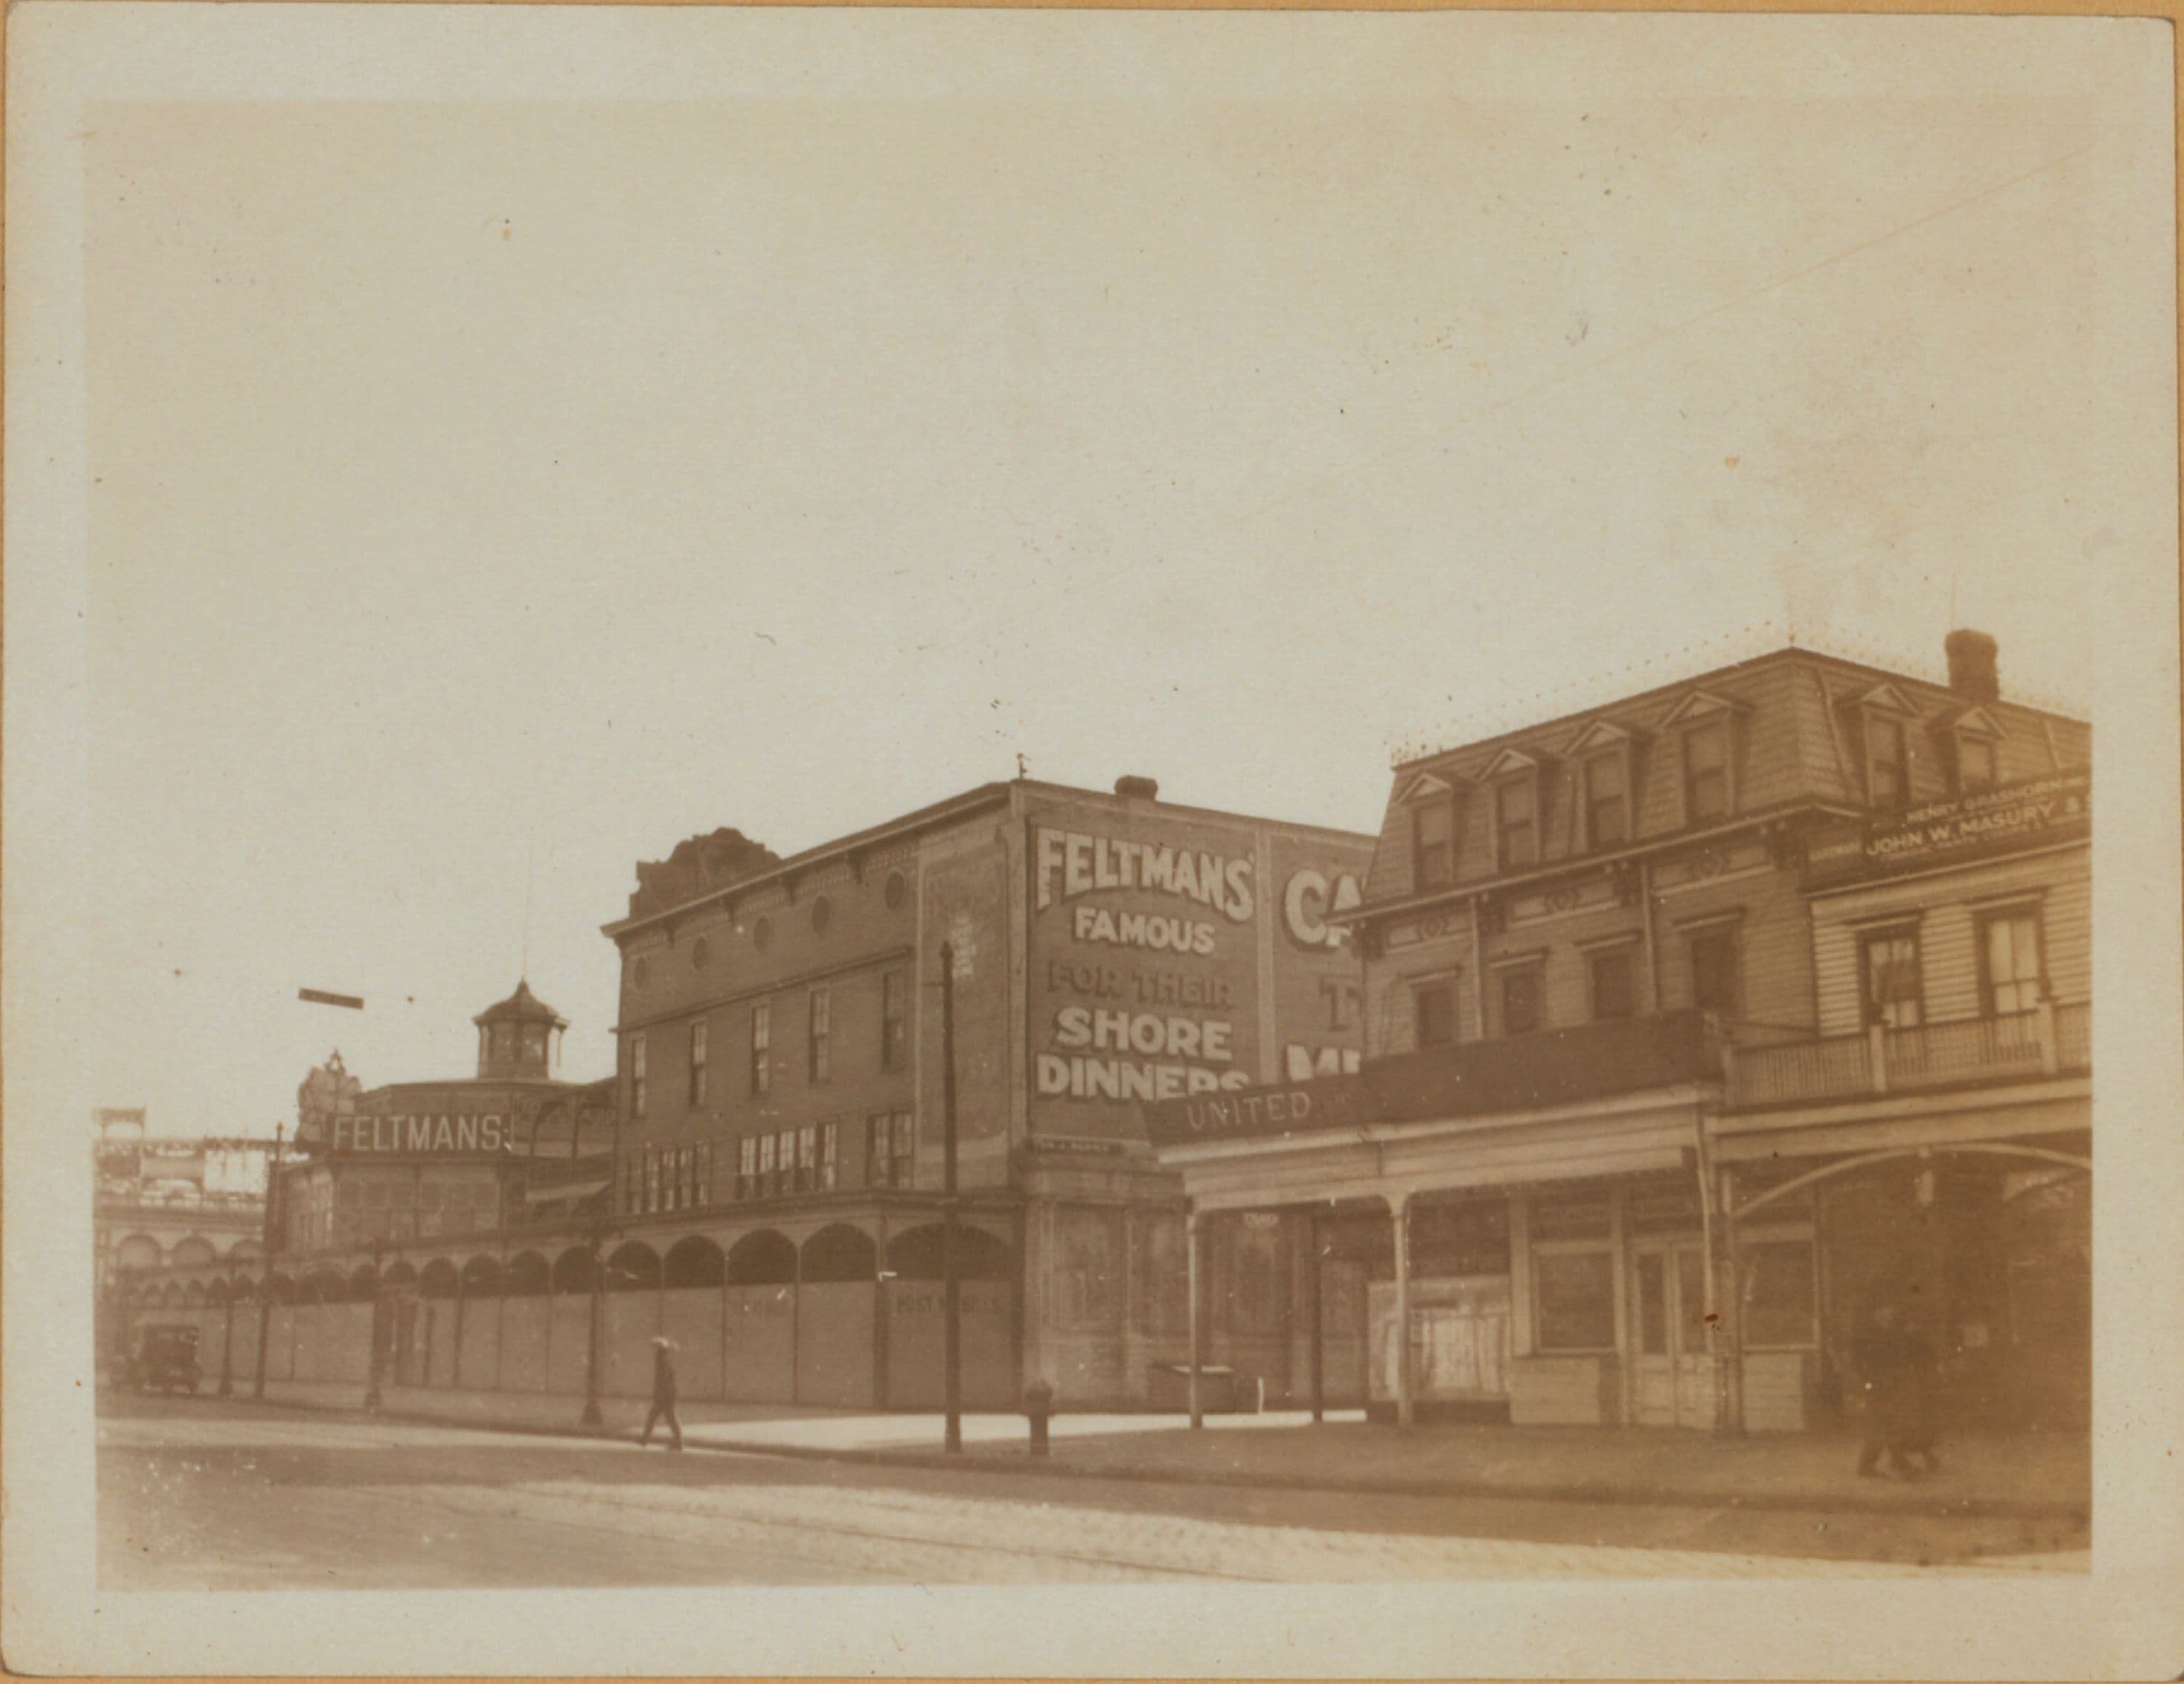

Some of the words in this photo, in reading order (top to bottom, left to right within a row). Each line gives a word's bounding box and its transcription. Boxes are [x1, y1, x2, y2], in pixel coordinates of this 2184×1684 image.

[1865, 831, 1922, 857] JOHN
[1959, 801, 2057, 835] MASURY
[1074, 907, 1215, 954] FAMOUS
[1285, 870, 1367, 947] CA
[1047, 963, 1121, 998] FOR
[1132, 971, 1234, 1011] THEIR
[1055, 1007, 1233, 1061] SHORE
[333, 1114, 502, 1152] FELTMANS
[1187, 1092, 1311, 1131] UNITED
